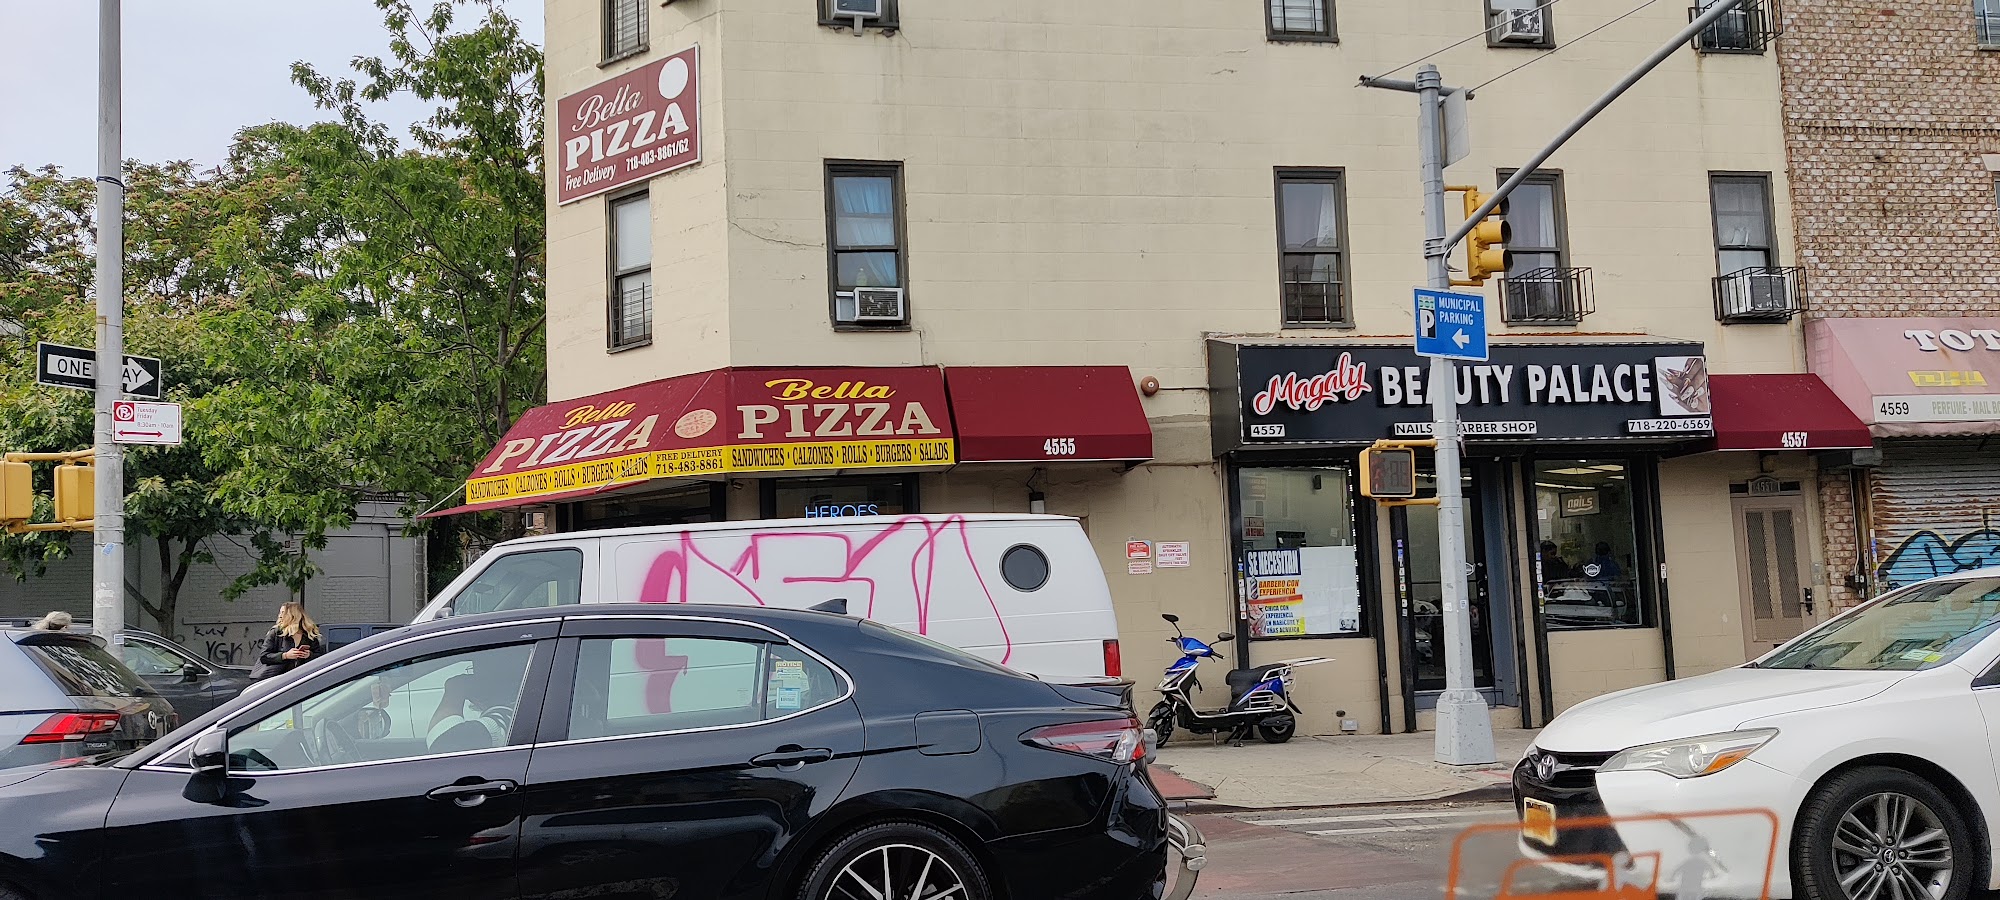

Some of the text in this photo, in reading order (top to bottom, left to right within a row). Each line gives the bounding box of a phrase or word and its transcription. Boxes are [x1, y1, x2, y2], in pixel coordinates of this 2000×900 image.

[572, 83, 643, 132] Bella
[565, 102, 689, 172] PIZZA
[565, 138, 689, 191] Free Delivery 718-483-8861/62
[1438, 297, 1481, 312] MUNICIPAL
[1439, 311, 1474, 325] PARKING
[1904, 329, 2000, 352] TOT
[58, 359, 142, 384] ONE AY
[1914, 371, 1984, 386] DHL
[765, 378, 897, 401] Bella
[1253, 351, 1652, 416] Magaly BEUTY PALACE
[137, 406, 158, 414] Tuesday
[558, 400, 637, 430] Bella
[1880, 401, 1909, 416] 4559
[1932, 400, 1967, 415] PERFUME
[1973, 400, 1991, 415] MAIL
[737, 401, 941, 439] PIZZA
[1396, 423, 1433, 434] NAILS
[1502, 421, 1536, 433] SHOP
[1629, 419, 1711, 431] 718-220-6569
[1253, 425, 1284, 436] 4557
[482, 413, 660, 475] PIZZA
[1043, 437, 1076, 456] 4555
[1781, 432, 1808, 448] 4557
[656, 448, 723, 462] FREE DELIVERY
[732, 441, 949, 468] SANDWICHES CALZONES ROLLS BURGERS SALADS
[656, 458, 724, 475] 718-483-8861
[470, 478, 509, 500] SANDWICHES
[554, 468, 576, 488] ROLLS
[582, 461, 614, 484] BURGERS
[621, 456, 649, 478] SALADS
[805, 504, 878, 519] HEROES
[1248, 550, 1298, 575] SE NECESITAN
[1259, 580, 1286, 588] BARBERO
[1259, 588, 1296, 596] EXPERIENCIA
